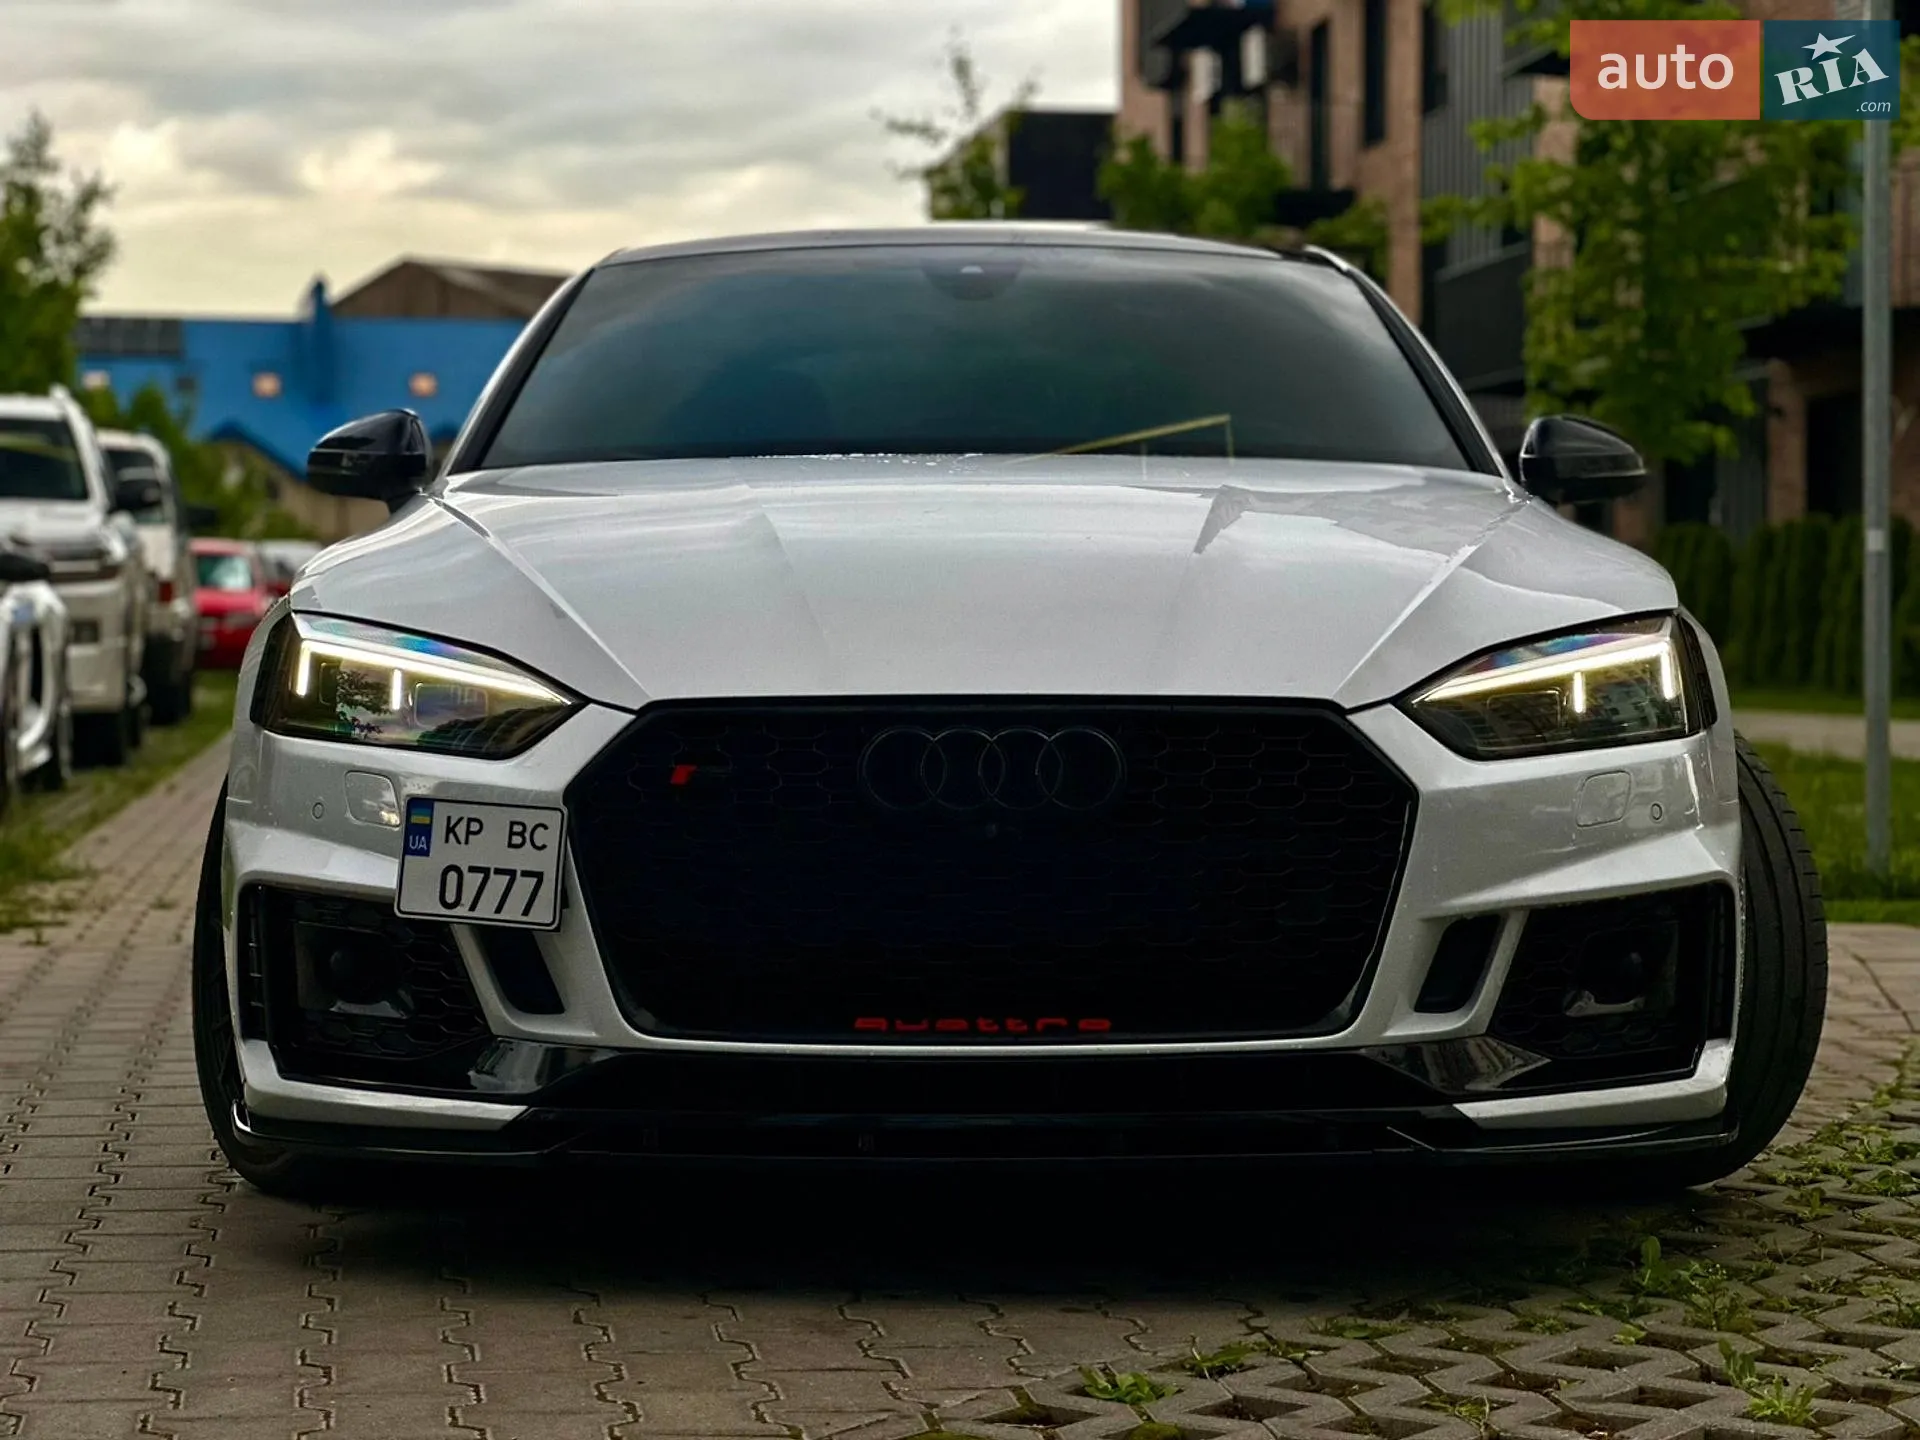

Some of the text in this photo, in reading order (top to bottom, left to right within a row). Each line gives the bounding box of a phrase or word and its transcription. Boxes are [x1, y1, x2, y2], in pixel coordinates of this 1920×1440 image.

[409, 835, 428, 850] UA
[444, 815, 549, 851] KP BC
[438, 864, 545, 917] 0777
[853, 1016, 1112, 1033] quattro
